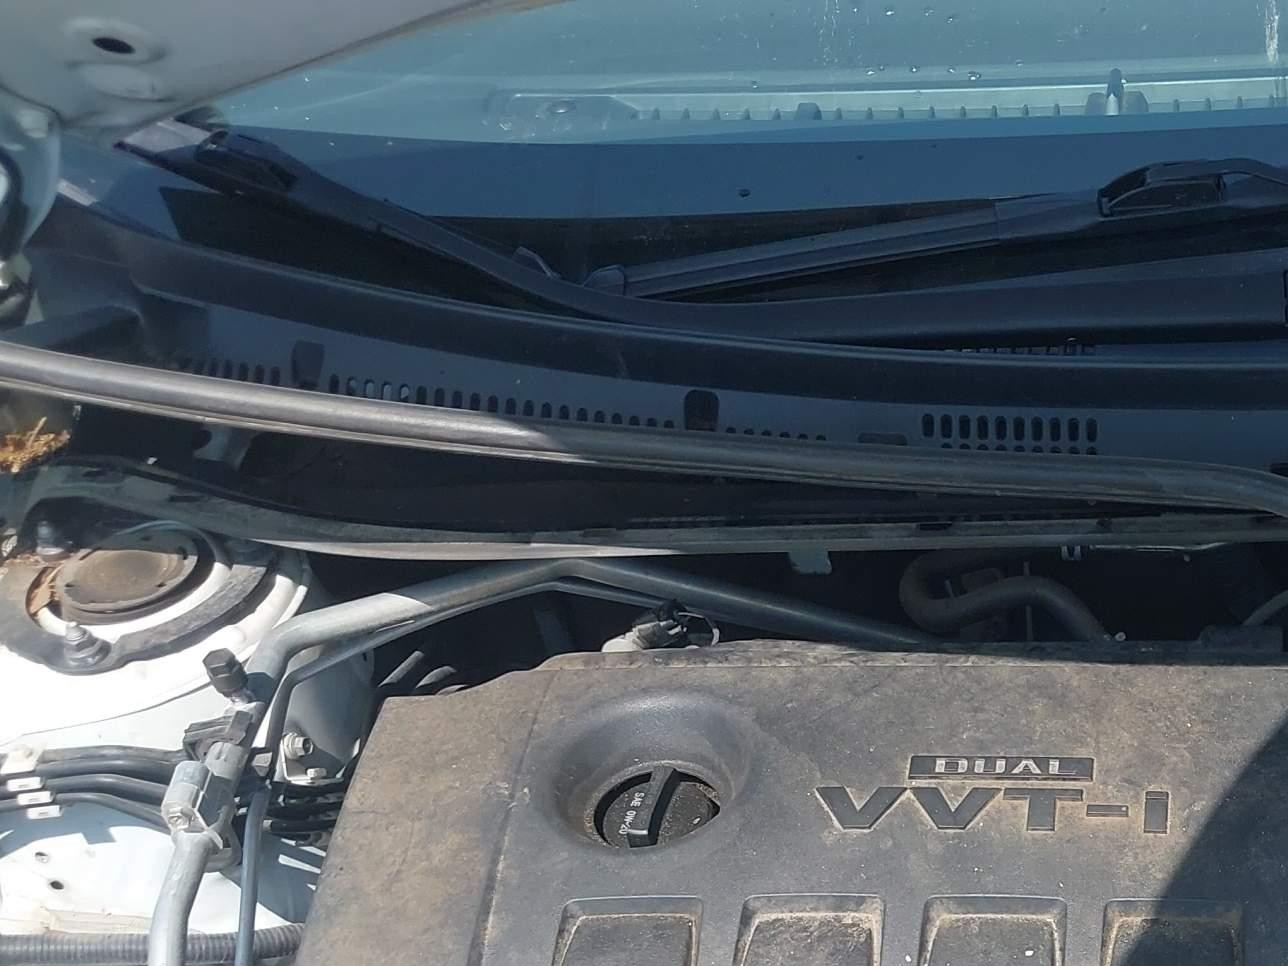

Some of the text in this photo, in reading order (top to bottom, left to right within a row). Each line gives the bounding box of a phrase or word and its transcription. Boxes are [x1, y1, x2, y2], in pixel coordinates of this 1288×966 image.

[935, 758, 1077, 774] DUAL
[618, 792, 645, 835] SAE 0W-20
